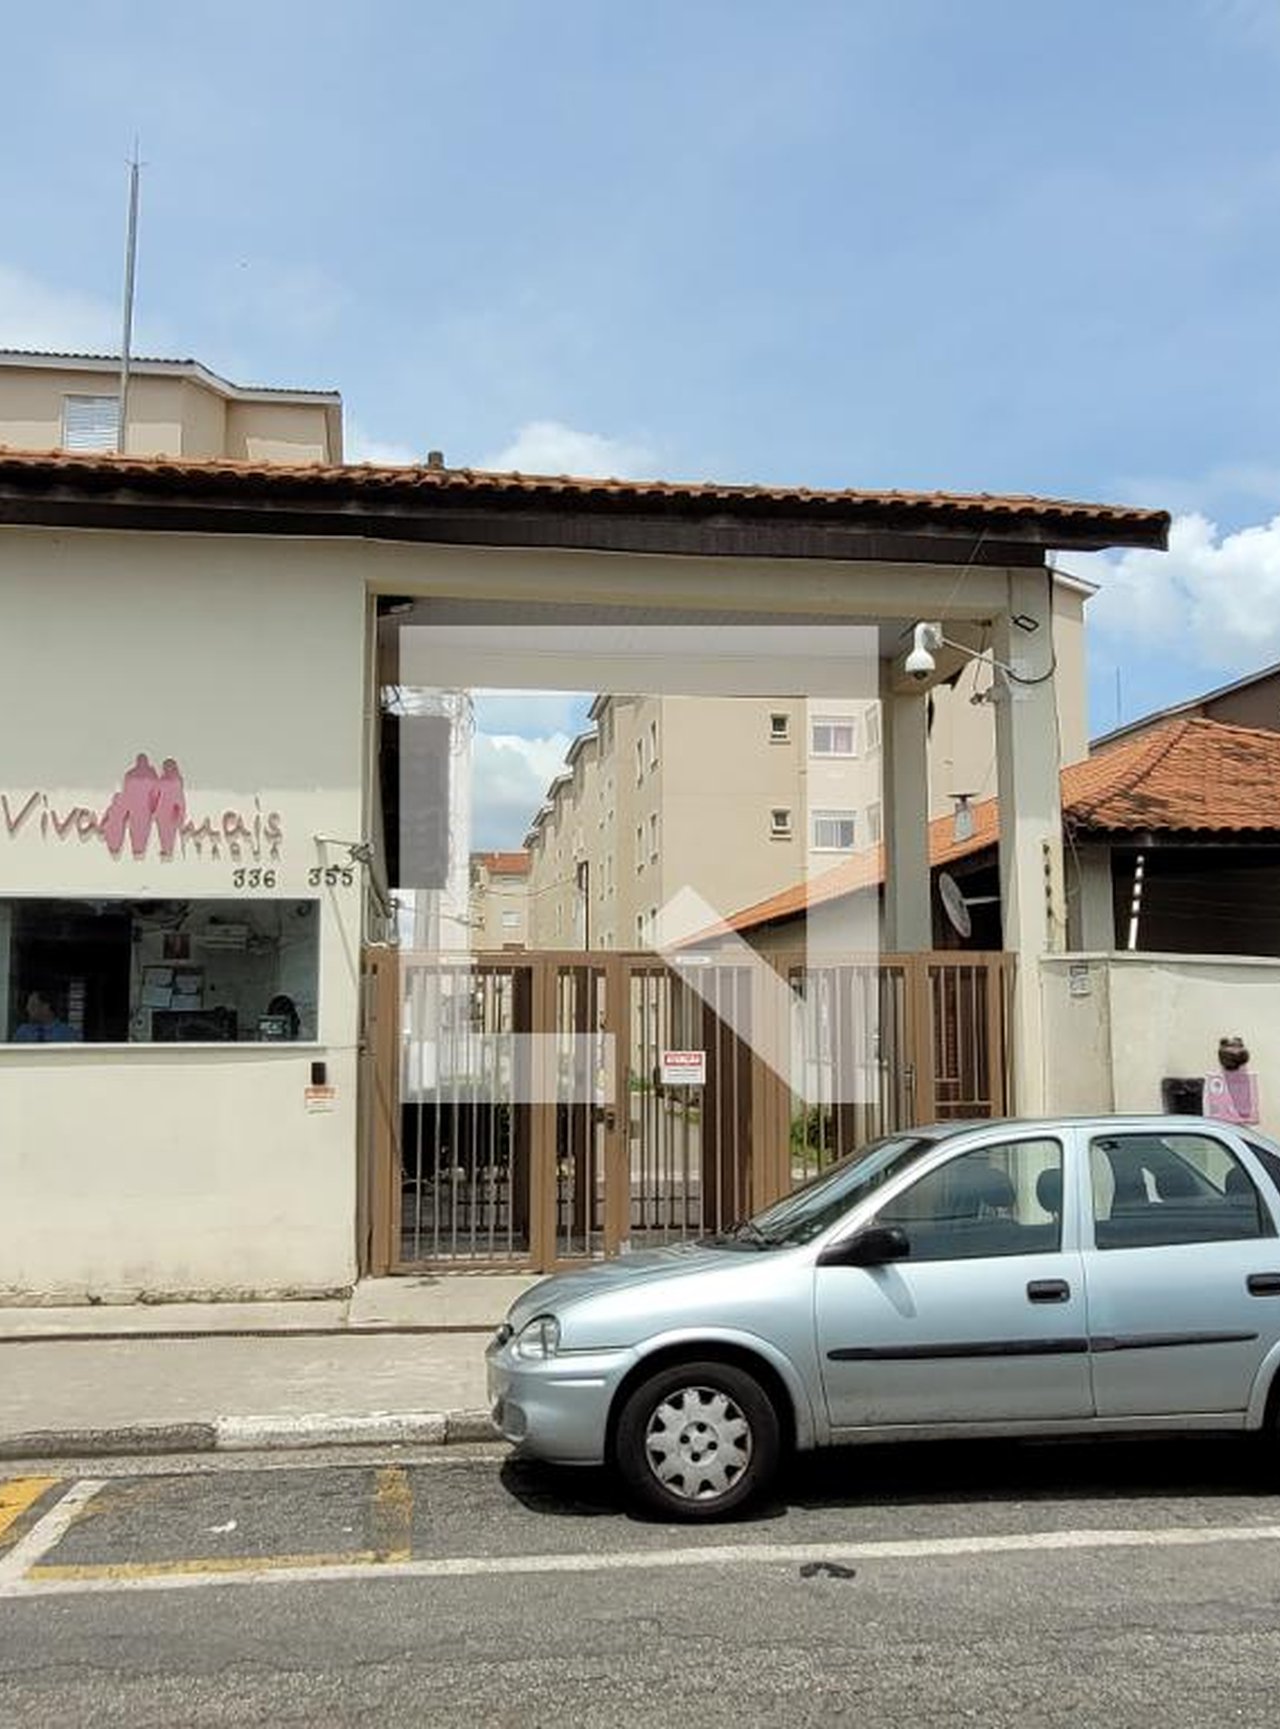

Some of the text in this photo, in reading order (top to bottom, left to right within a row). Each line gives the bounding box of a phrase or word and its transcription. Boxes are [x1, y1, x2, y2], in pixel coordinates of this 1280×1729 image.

[1, 791, 105, 838] Viva
[232, 867, 354, 888] 336 355
